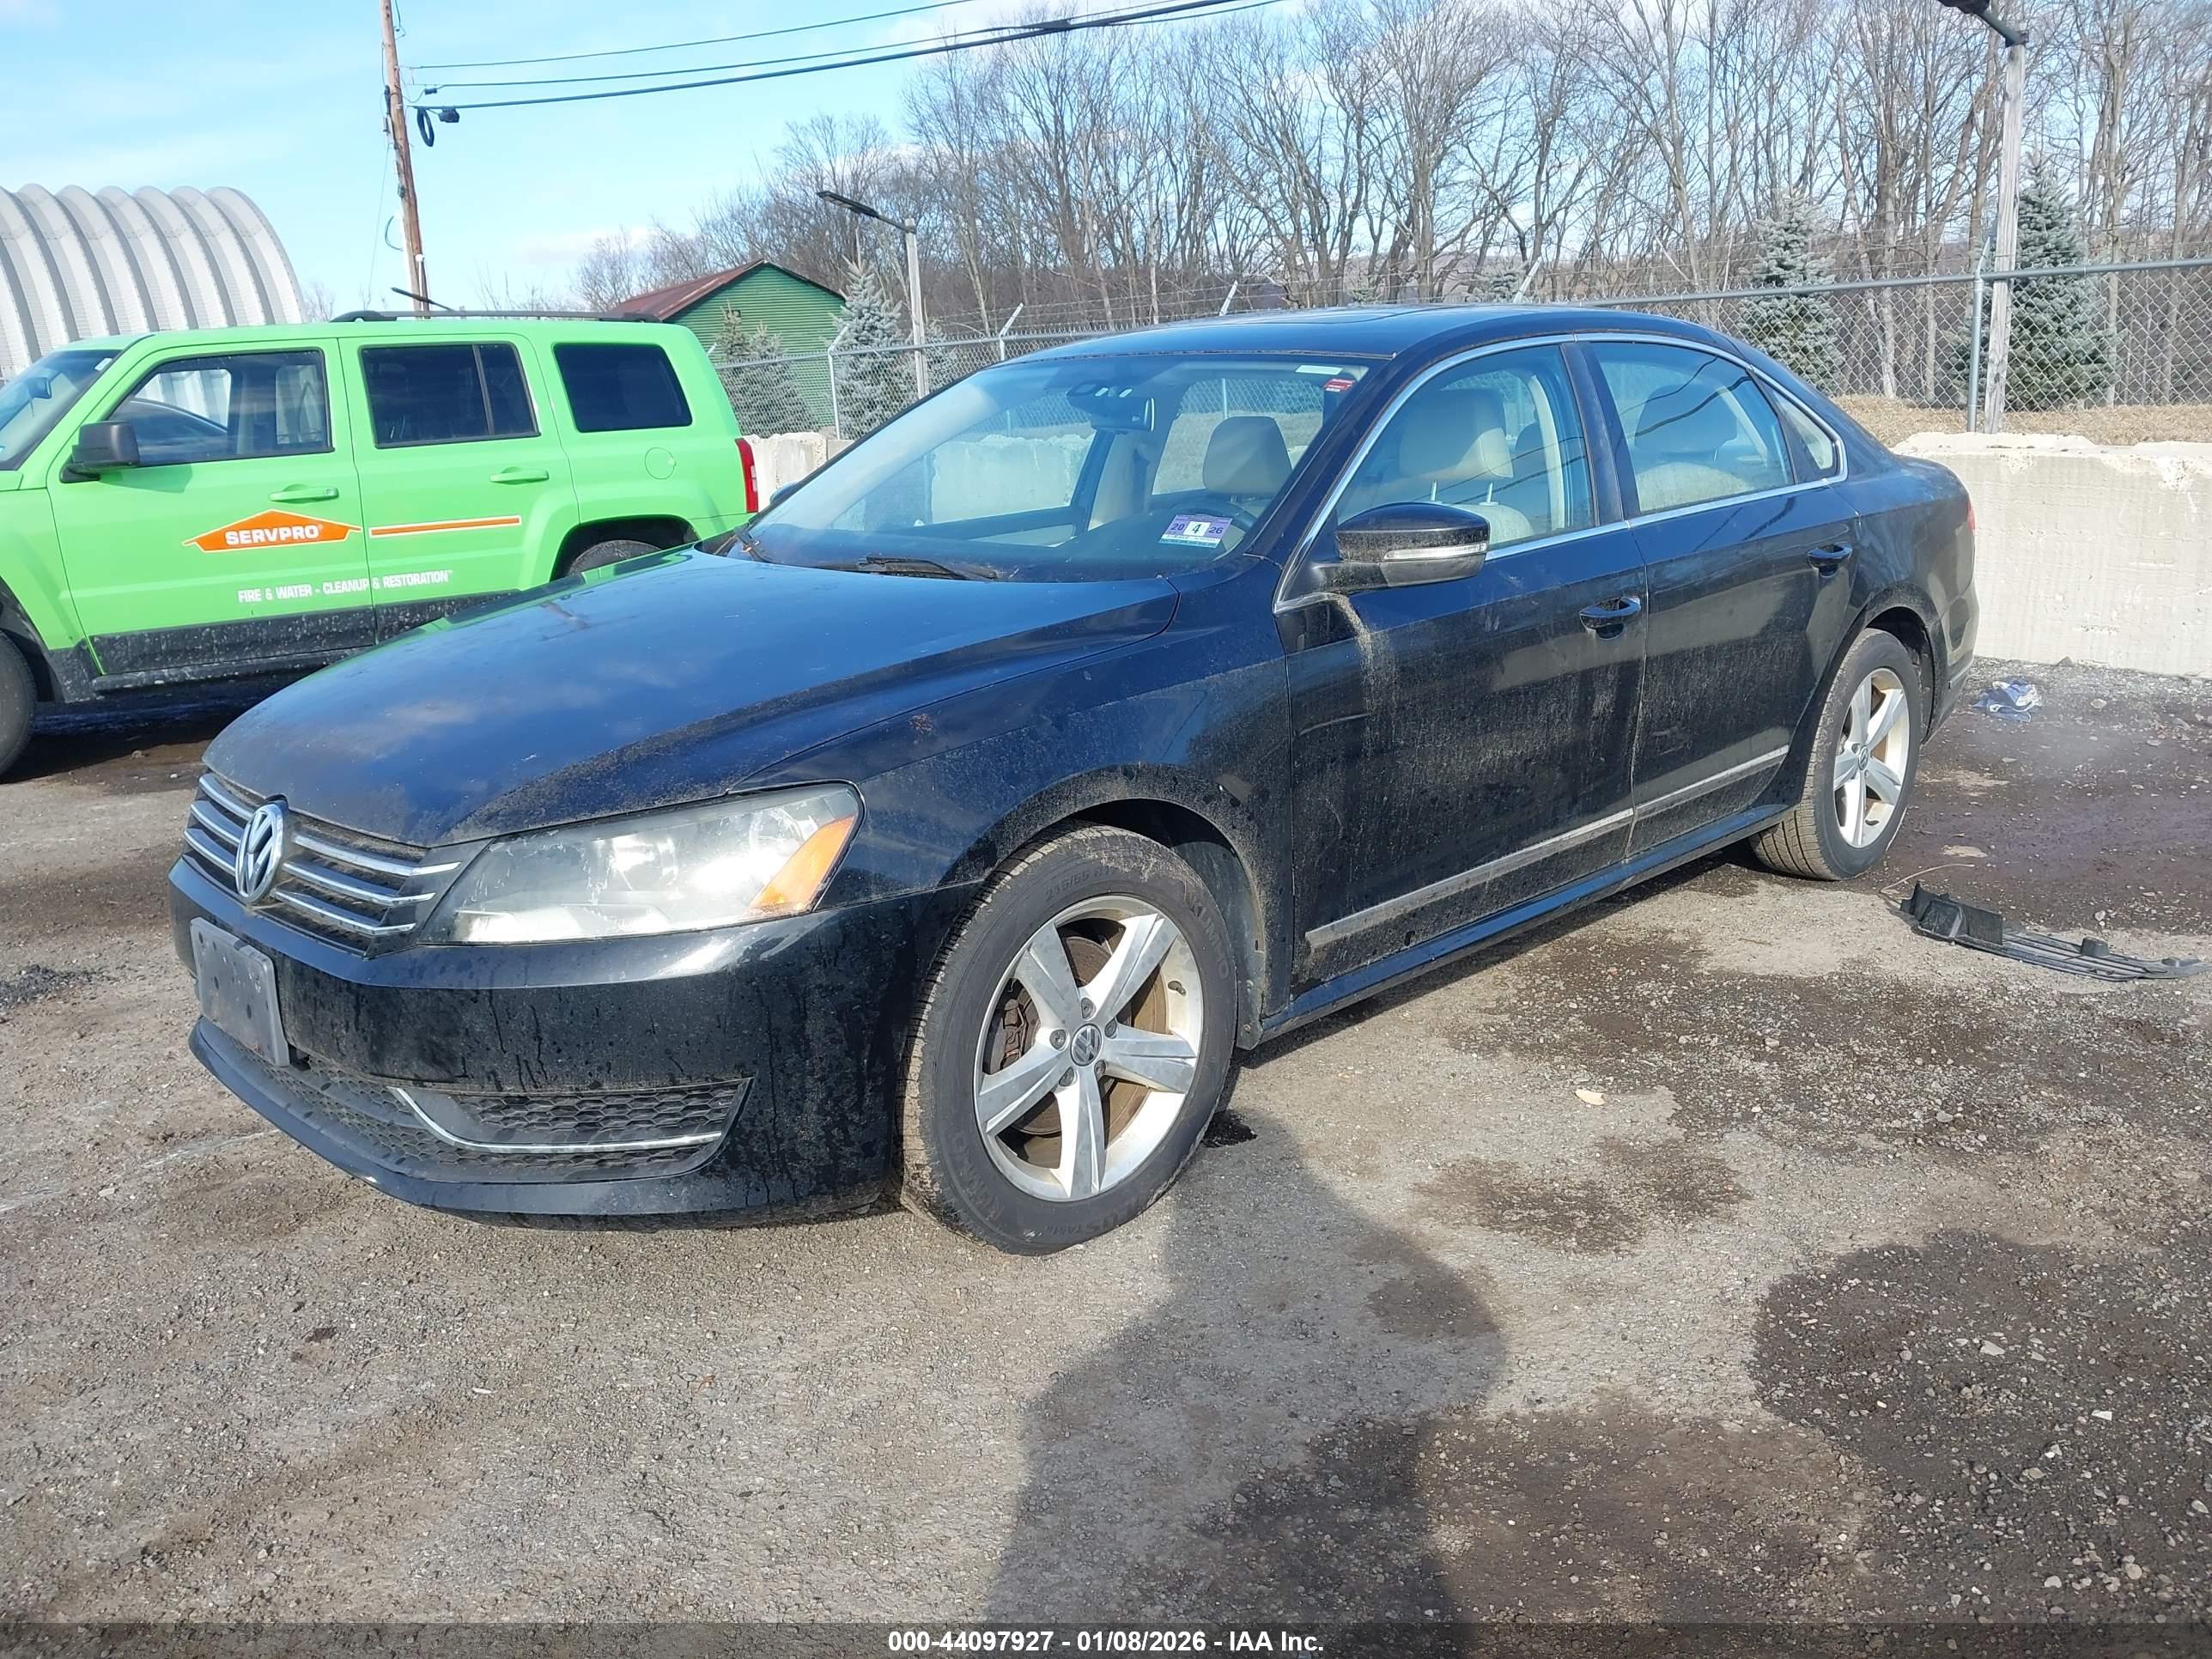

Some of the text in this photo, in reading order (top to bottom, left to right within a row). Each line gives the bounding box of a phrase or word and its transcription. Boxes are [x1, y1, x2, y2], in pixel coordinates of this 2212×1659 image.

[225, 525, 319, 545] SERVPRO
[1192, 524, 1202, 534] 4
[238, 588, 261, 603] FIRE
[265, 587, 273, 601] &
[275, 584, 313, 599] WATER
[322, 578, 369, 595] CLEANUP
[372, 577, 380, 590] &
[382, 570, 448, 589] RESTORATION
